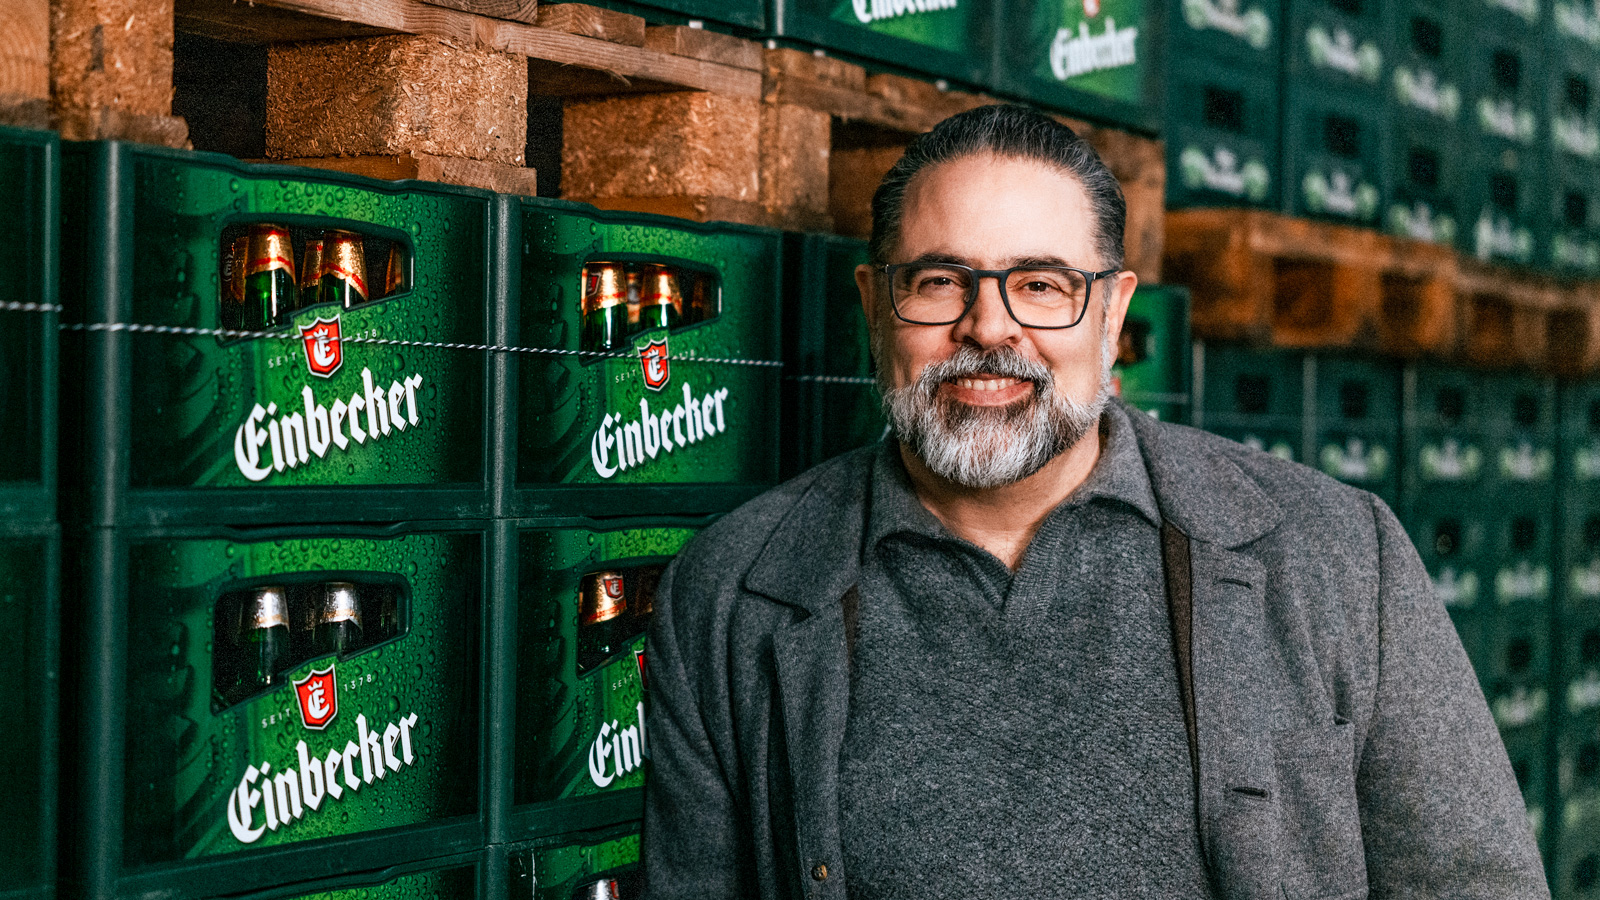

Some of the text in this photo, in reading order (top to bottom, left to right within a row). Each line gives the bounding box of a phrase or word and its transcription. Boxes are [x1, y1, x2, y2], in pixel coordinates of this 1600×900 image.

[268, 352, 297, 369] SEIT
[615, 369, 637, 384] SEIT
[234, 366, 423, 482] Einbecker
[591, 382, 728, 479] Einbecker
[261, 673, 372, 729] SEIT 1378
[308, 688, 330, 719] E
[612, 674, 633, 691] SEIT
[227, 711, 418, 844] Einbecker
